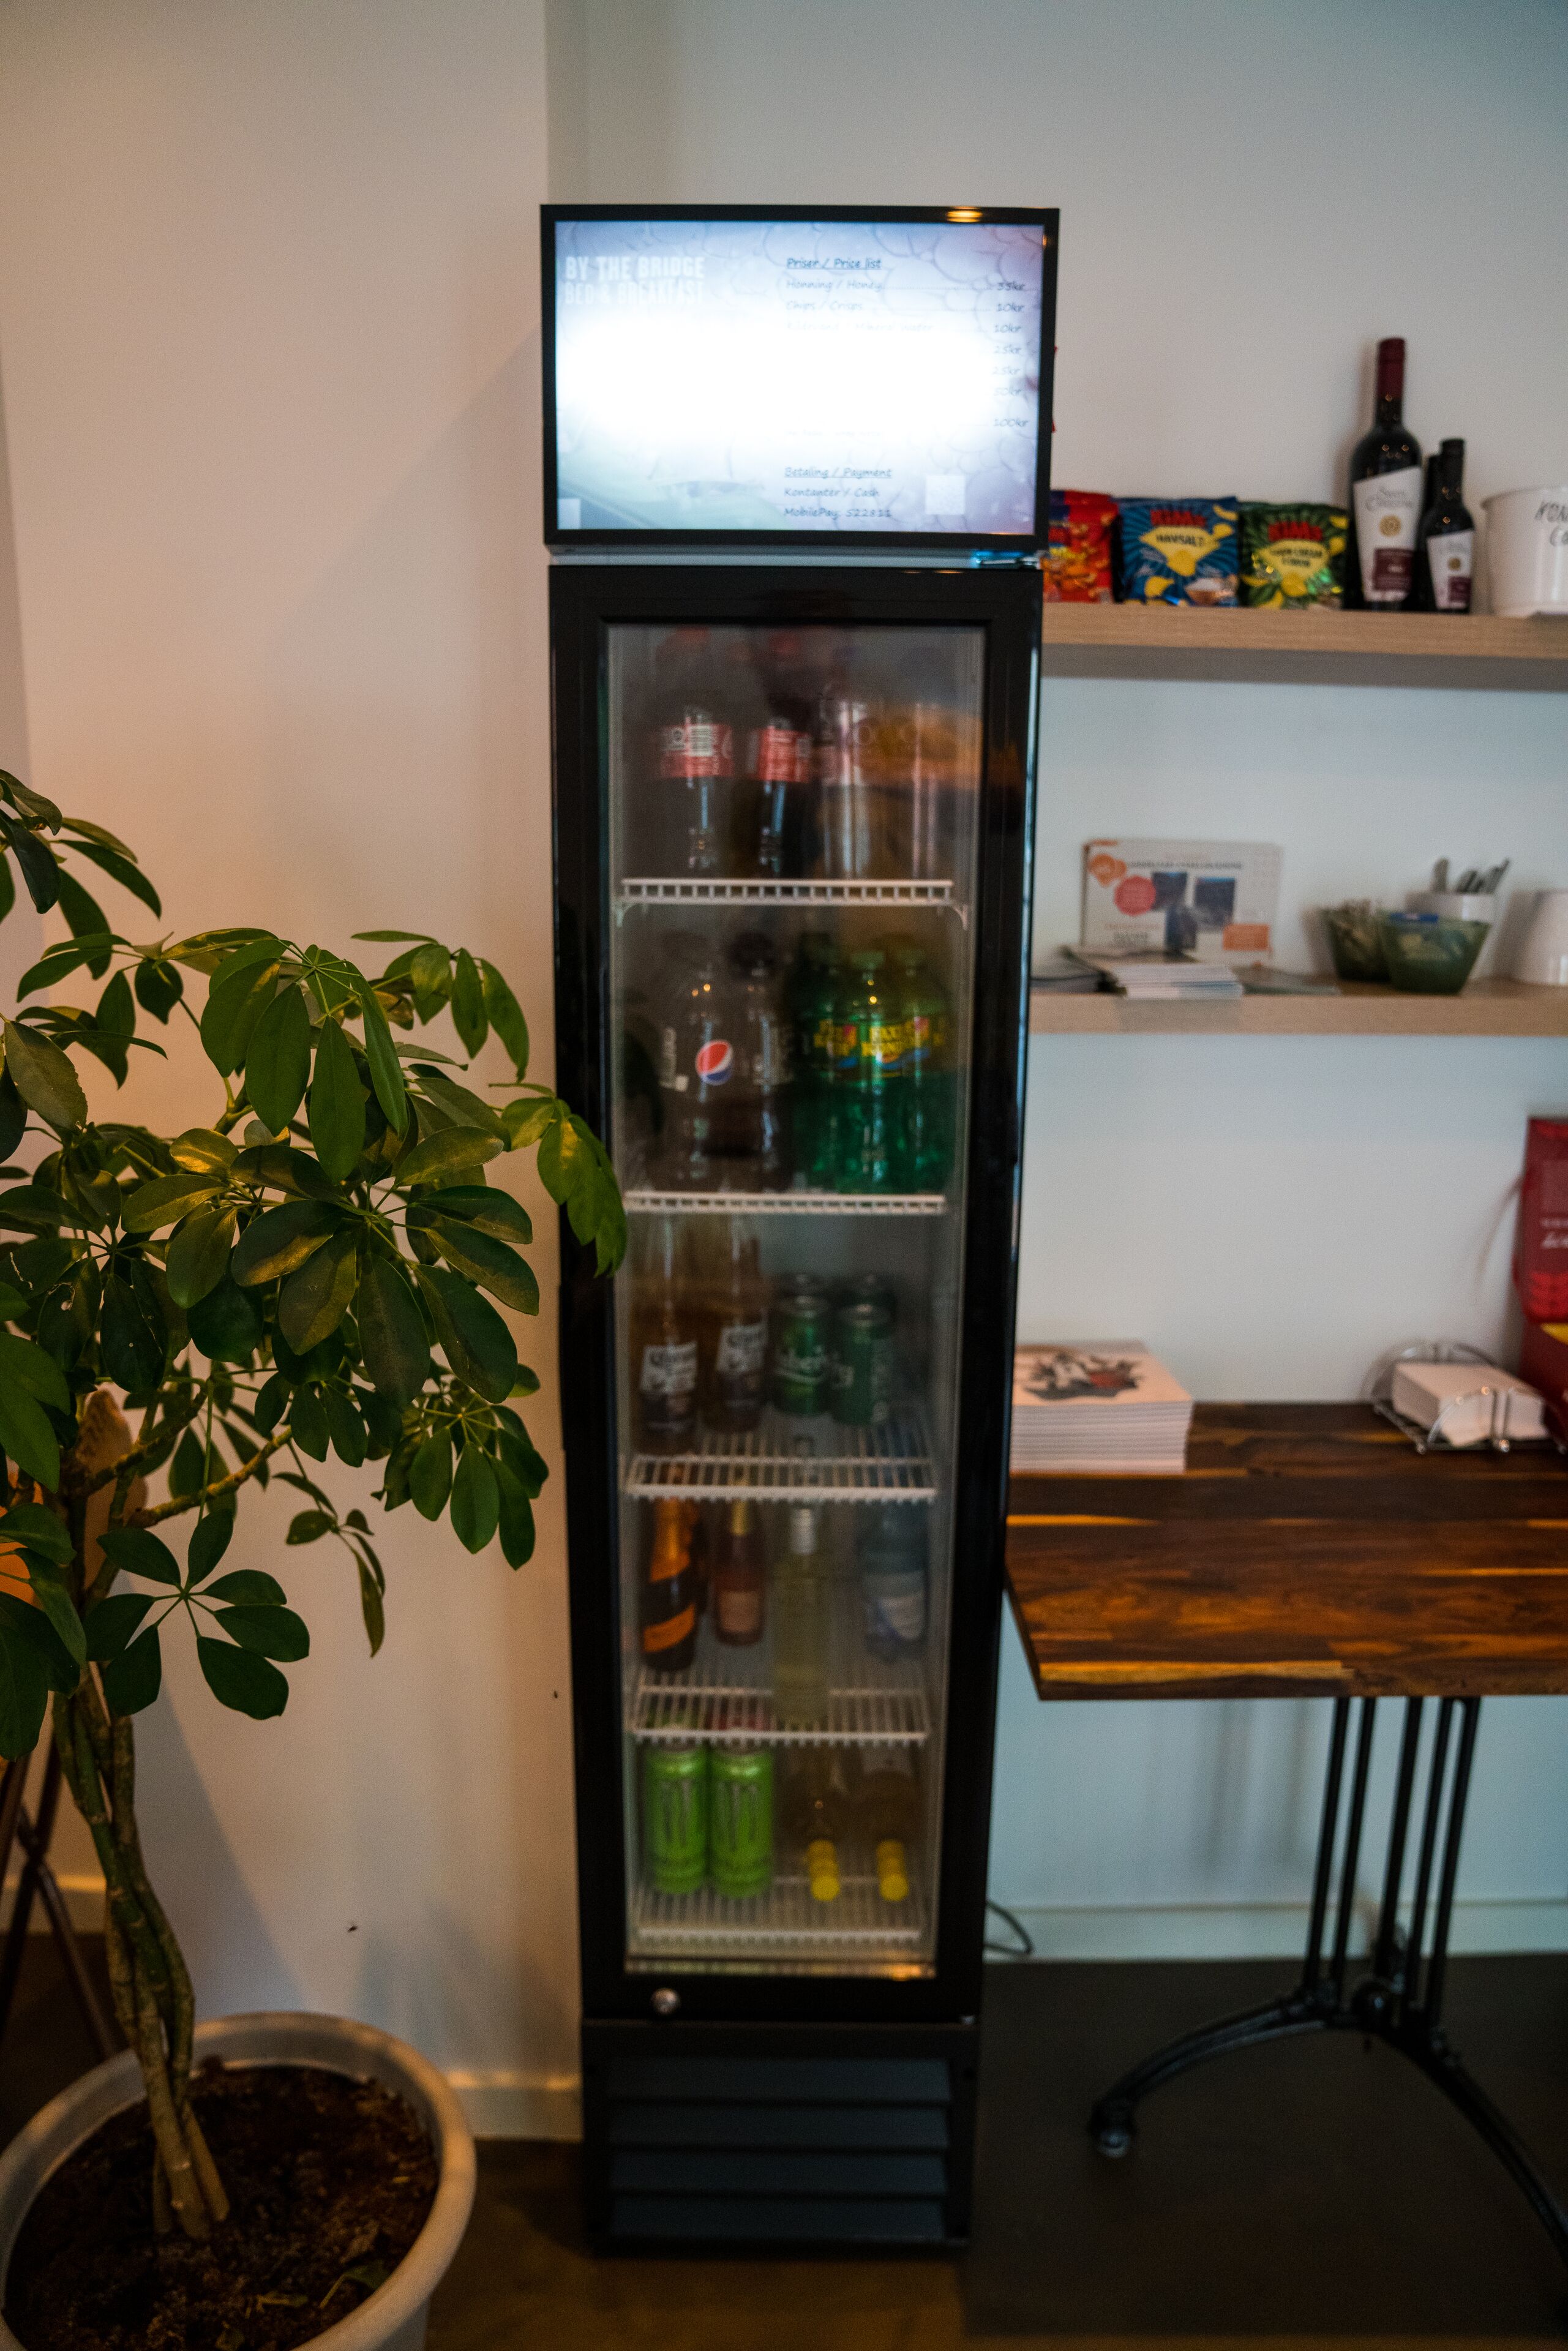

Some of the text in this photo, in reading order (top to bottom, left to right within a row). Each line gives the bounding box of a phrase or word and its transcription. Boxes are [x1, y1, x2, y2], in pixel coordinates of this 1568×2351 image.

[786, 258, 820, 268] Priser
[833, 258, 861, 268] Price
[865, 257, 882, 269] list
[565, 257, 705, 282] BY THE BRIDGE
[564, 279, 705, 305] BED & BREAKFAST
[784, 467, 828, 479] Betaling
[842, 467, 892, 479] Payment
[784, 488, 841, 497] Kontanter
